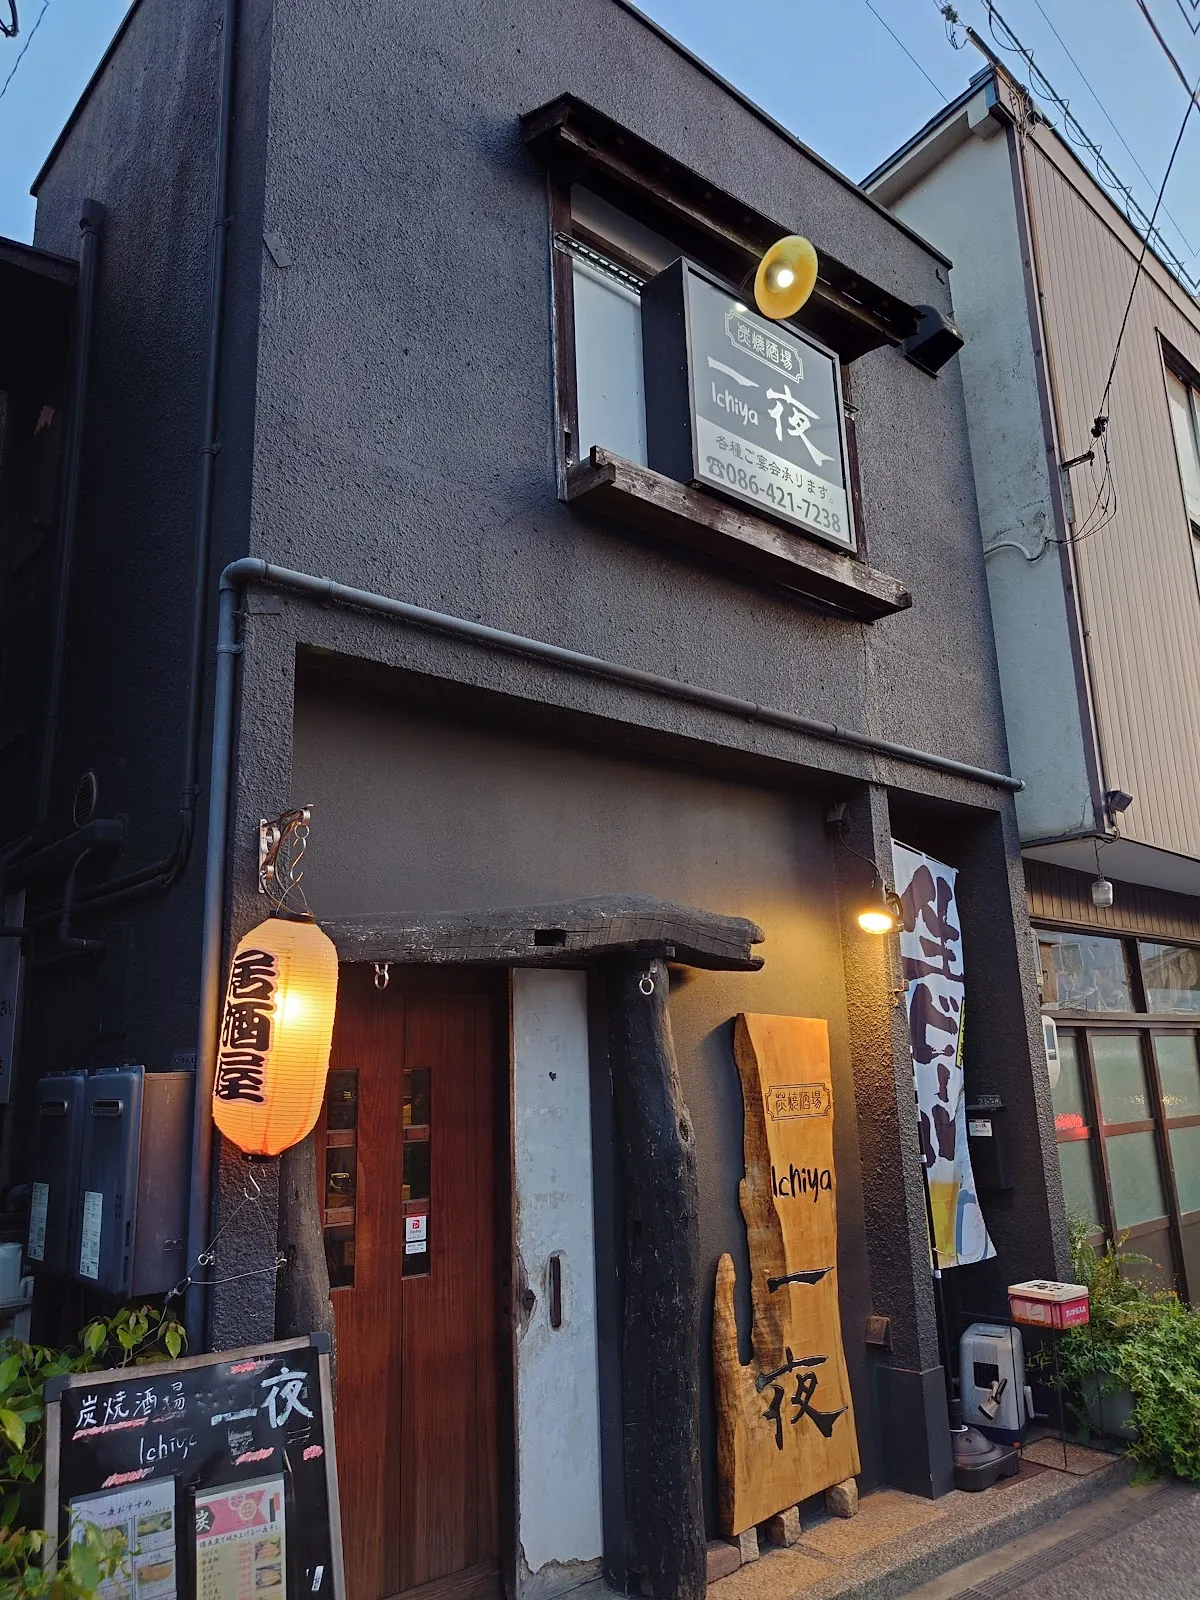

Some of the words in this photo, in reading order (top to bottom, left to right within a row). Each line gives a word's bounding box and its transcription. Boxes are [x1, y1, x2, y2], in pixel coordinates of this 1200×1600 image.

[737, 321, 793, 371] 炭焼酒場
[707, 356, 836, 468] 一夜
[711, 381, 759, 426] Ichiya
[715, 434, 834, 504] 各種ご宴会承ります。
[725, 462, 842, 533] 086-421-7238
[215, 949, 276, 1103] 居酒屋
[900, 864, 965, 1169] 生ビール
[775, 1090, 822, 1114] 炭焼酒場
[771, 1163, 832, 1204] Ichiya
[755, 1266, 849, 1450] 一夜
[75, 1381, 186, 1428] 炭焼酒場
[211, 1366, 315, 1429] 一夜
